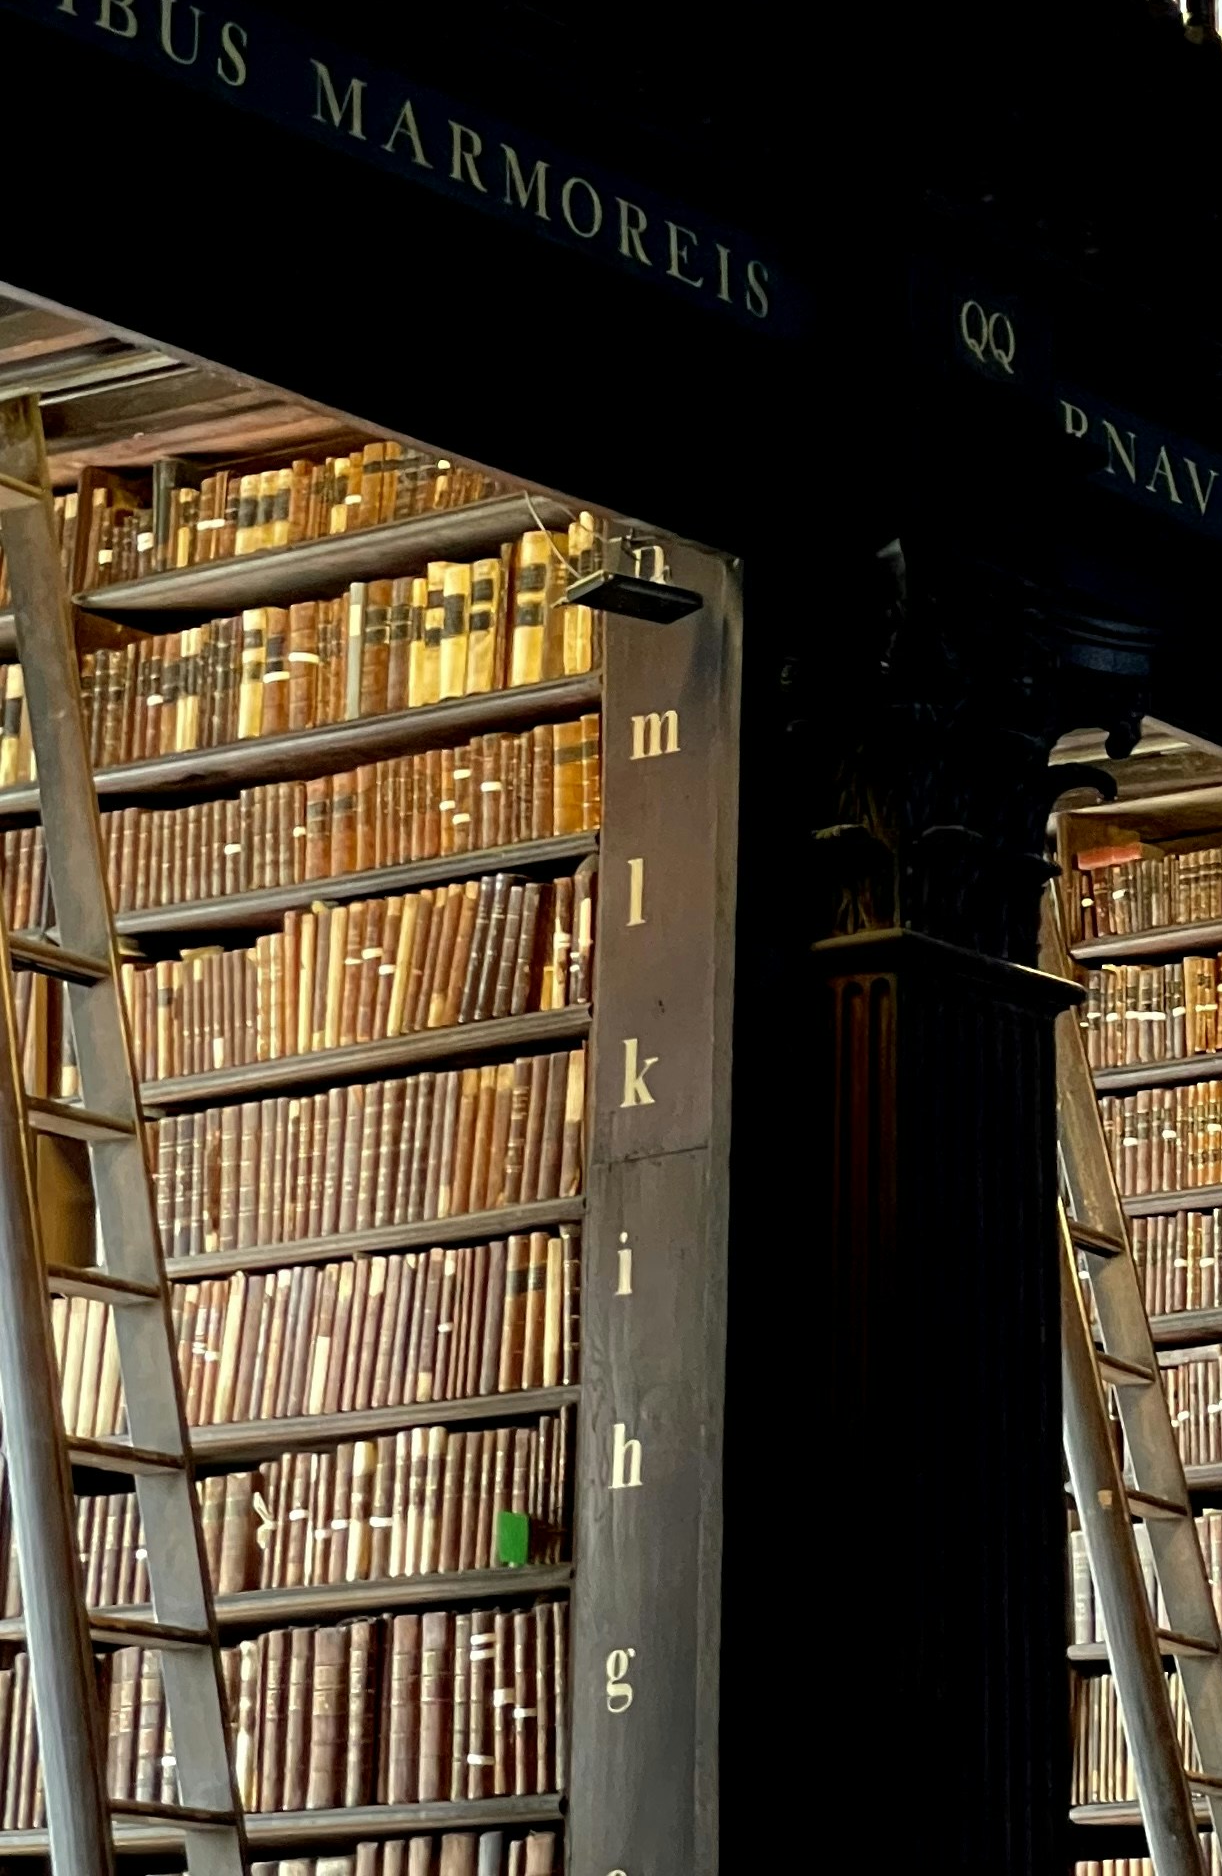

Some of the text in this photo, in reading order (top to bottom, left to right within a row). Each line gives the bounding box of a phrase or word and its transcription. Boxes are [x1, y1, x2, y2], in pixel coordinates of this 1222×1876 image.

[309, 57, 770, 319] MARMOREIS
[960, 299, 1016, 375] QQ
[630, 710, 682, 761] m
[618, 1037, 661, 1109] k
[614, 1230, 633, 1297] i
[607, 1422, 644, 1491] h
[605, 1647, 637, 1714] g
